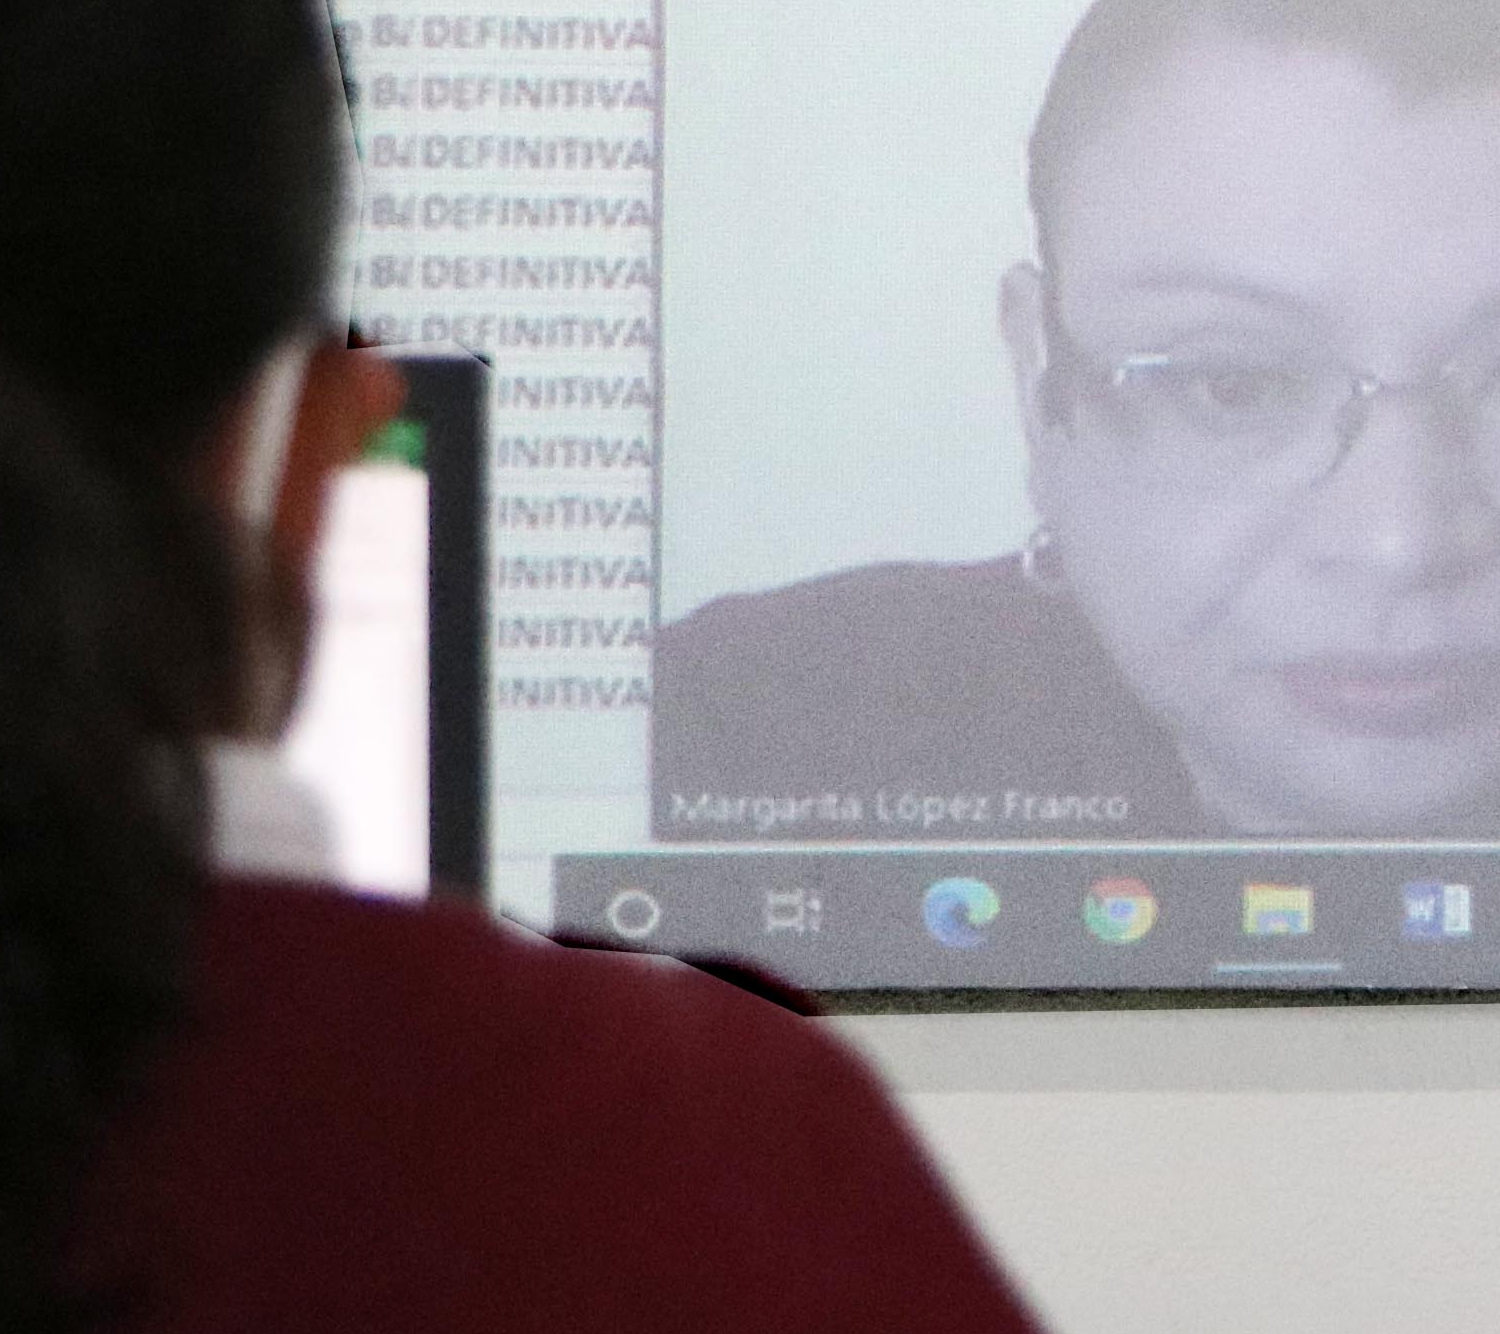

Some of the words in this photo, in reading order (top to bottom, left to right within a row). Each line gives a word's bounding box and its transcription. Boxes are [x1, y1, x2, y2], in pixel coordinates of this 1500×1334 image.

[422, 133, 656, 175] DEFINITIVA
[670, 791, 864, 833] Margarita
[875, 789, 991, 828] López
[1002, 788, 1130, 822] Franco
